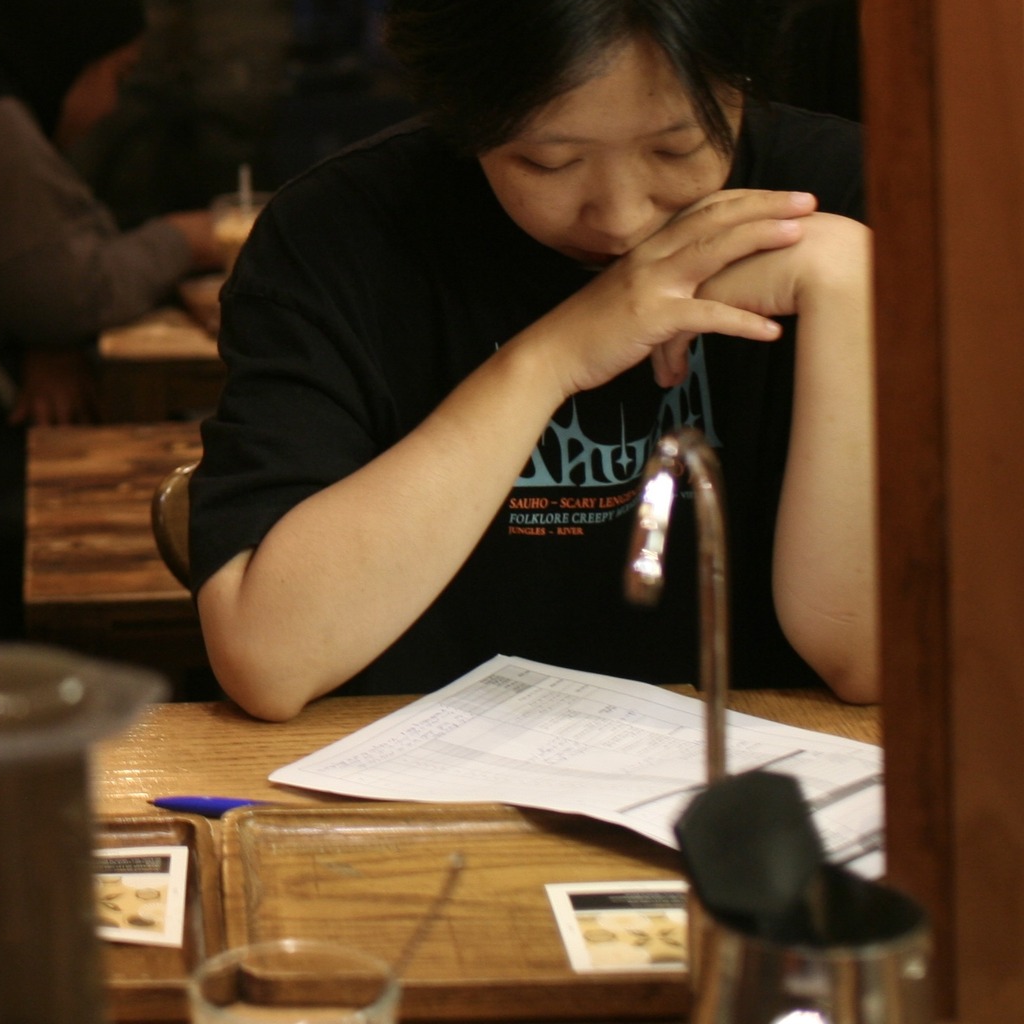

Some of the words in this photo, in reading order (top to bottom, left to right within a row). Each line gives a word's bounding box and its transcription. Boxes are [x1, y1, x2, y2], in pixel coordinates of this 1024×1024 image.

[509, 497, 548, 509] SAUHO
[559, 496, 597, 509] SCARY
[509, 513, 569, 525] FOLKLORE
[571, 510, 615, 525] CREEPY
[556, 526, 585, 536] RIVER
